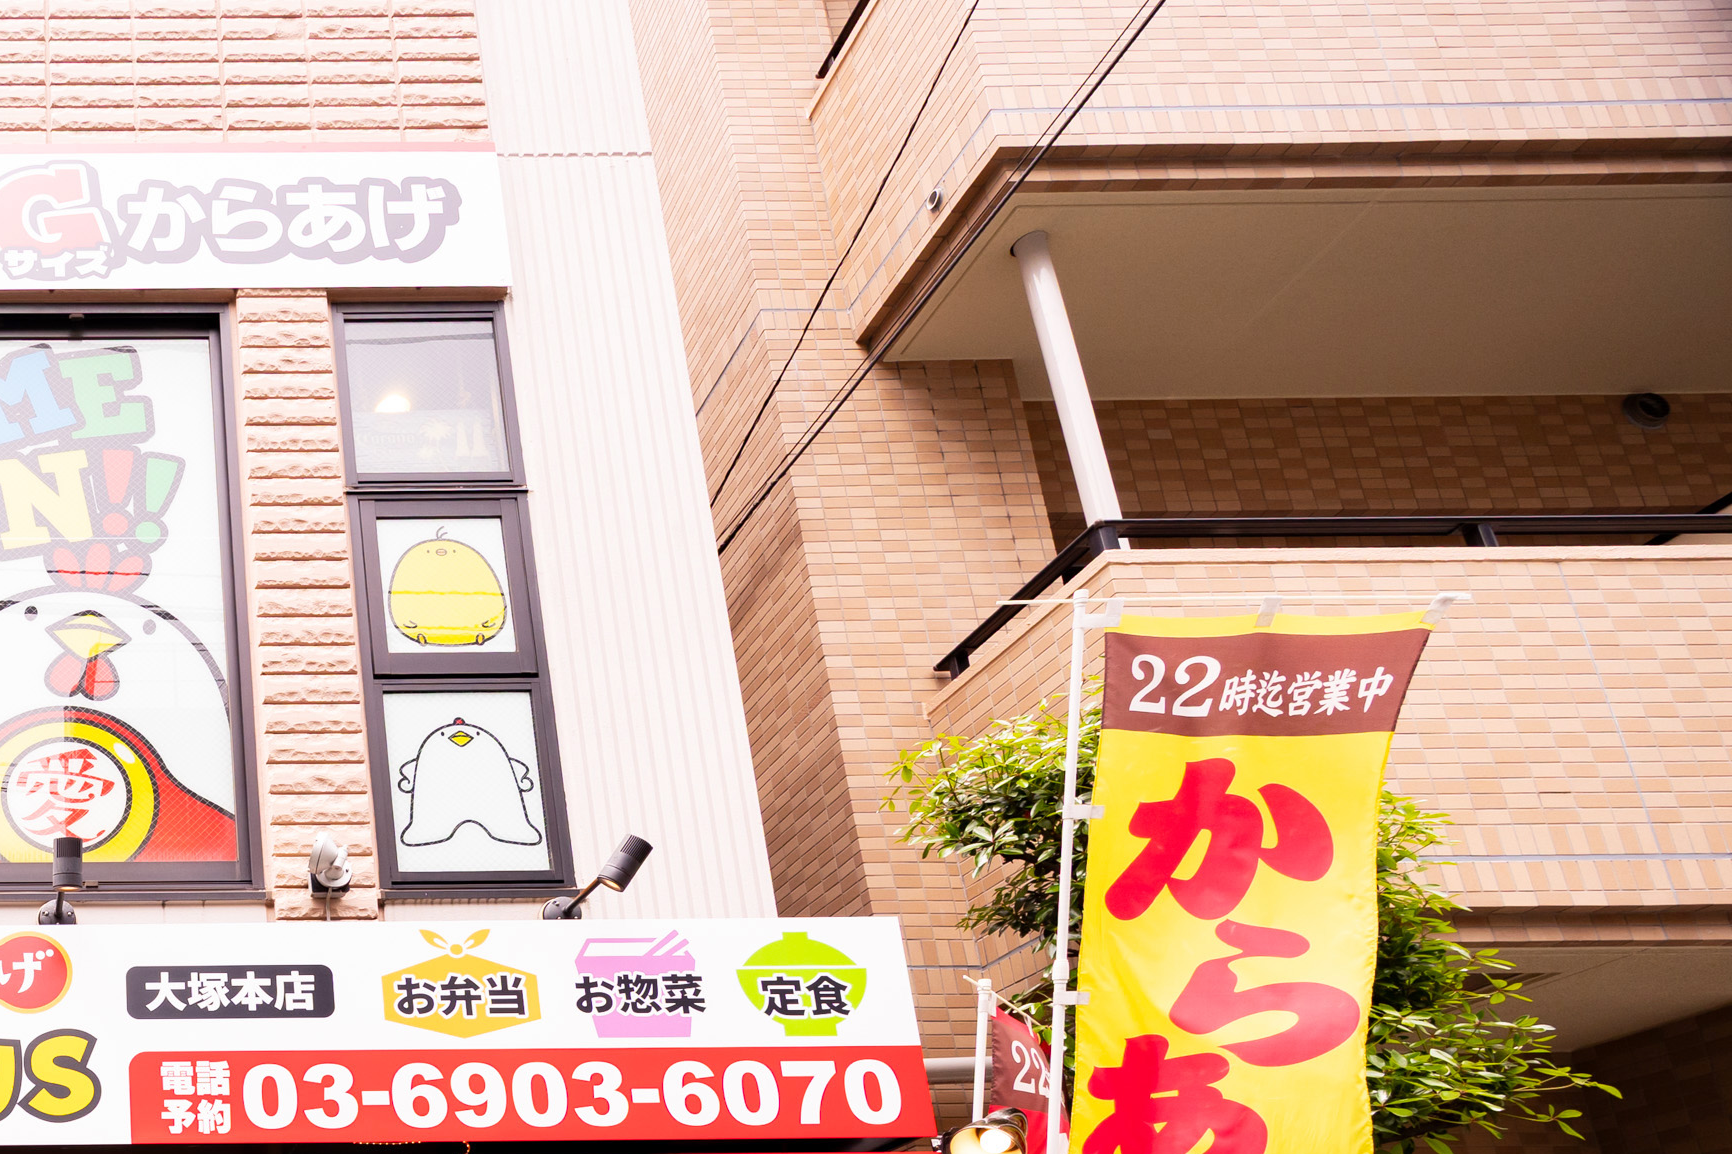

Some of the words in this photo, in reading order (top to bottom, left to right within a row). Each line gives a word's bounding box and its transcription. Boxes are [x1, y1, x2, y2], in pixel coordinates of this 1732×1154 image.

[4, 246, 114, 278] サイズ
[1128, 652, 1394, 719] 22時迄営業中
[15, 747, 116, 840] 愛
[144, 971, 316, 1013] 大塚本店
[394, 973, 529, 1018] お弁当
[574, 972, 707, 1016] お惣菜
[760, 975, 852, 1017] 定食
[160, 1061, 231, 1098] 電話
[242, 1060, 903, 1128] 03-6903-6070
[160, 1099, 231, 1136] 予約
